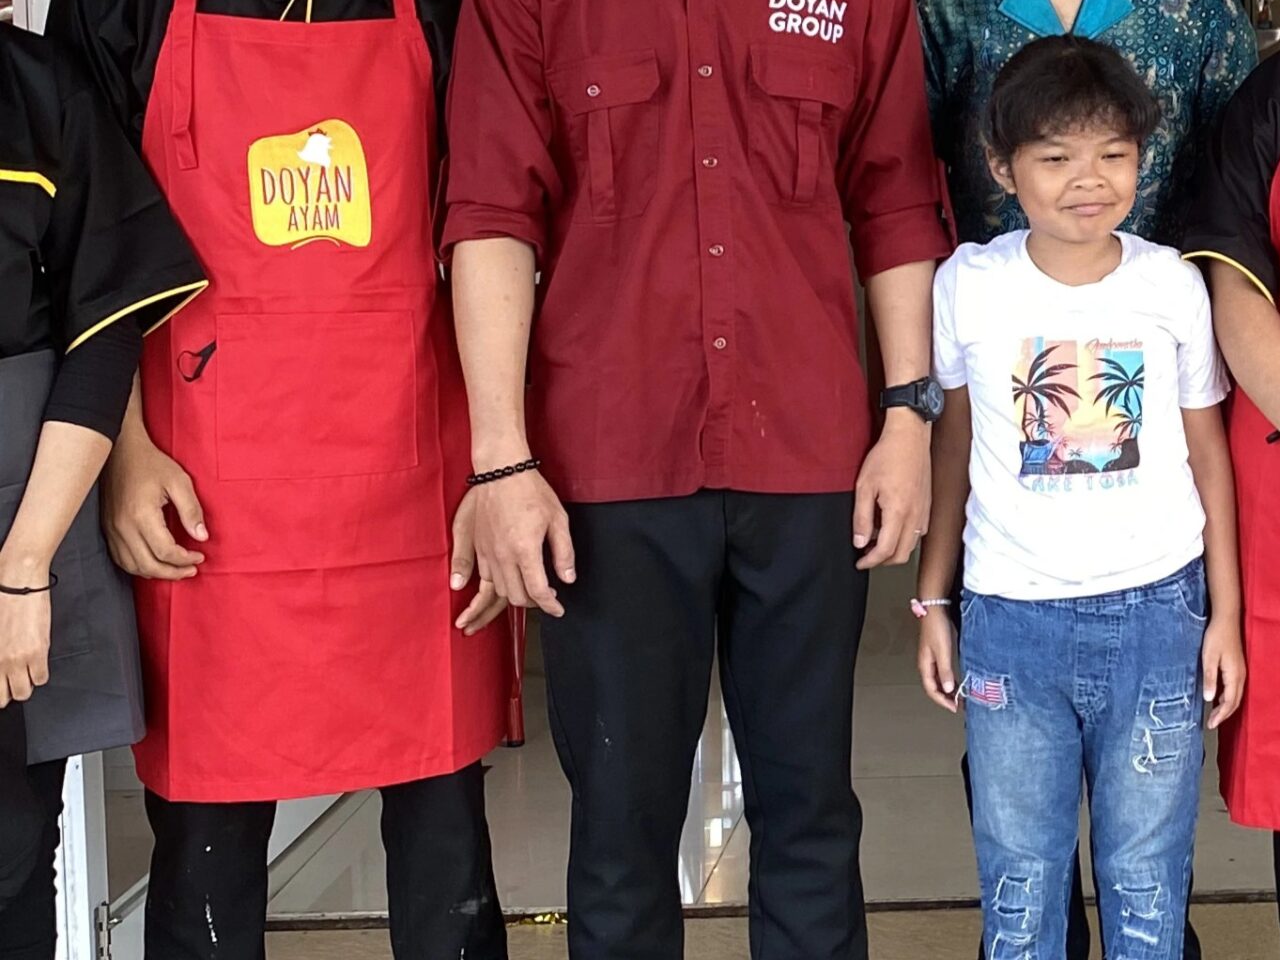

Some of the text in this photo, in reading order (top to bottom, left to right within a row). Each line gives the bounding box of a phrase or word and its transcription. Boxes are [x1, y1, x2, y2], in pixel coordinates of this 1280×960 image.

[768, 11, 844, 44] GROUP
[261, 165, 352, 205] DOYAN
[288, 204, 340, 231] AYAM
